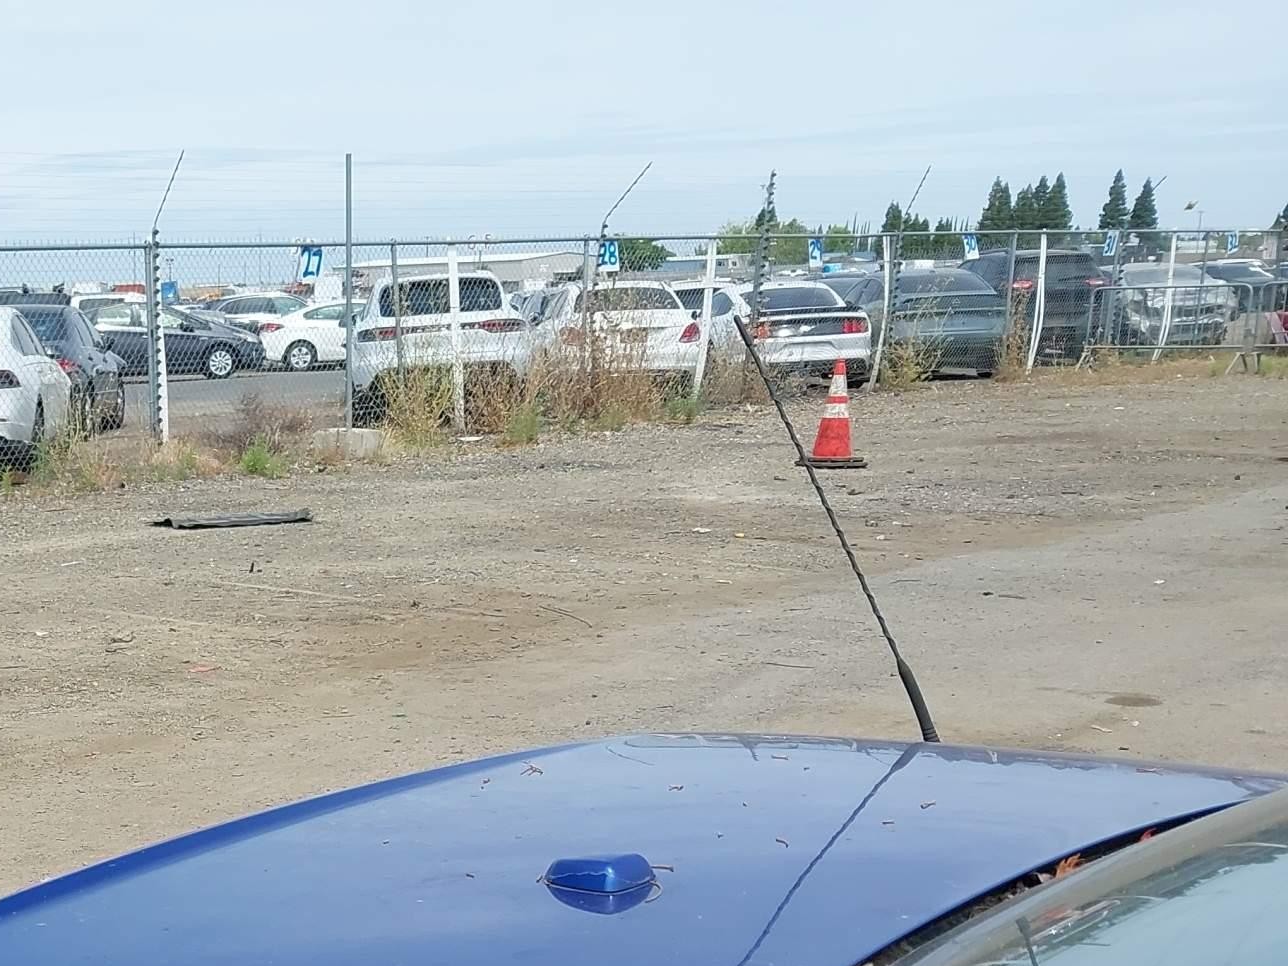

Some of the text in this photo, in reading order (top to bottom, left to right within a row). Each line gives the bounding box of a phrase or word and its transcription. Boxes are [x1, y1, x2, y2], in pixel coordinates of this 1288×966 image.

[599, 241, 617, 265] 28
[810, 239, 823, 260] 29
[301, 247, 322, 278] 27
